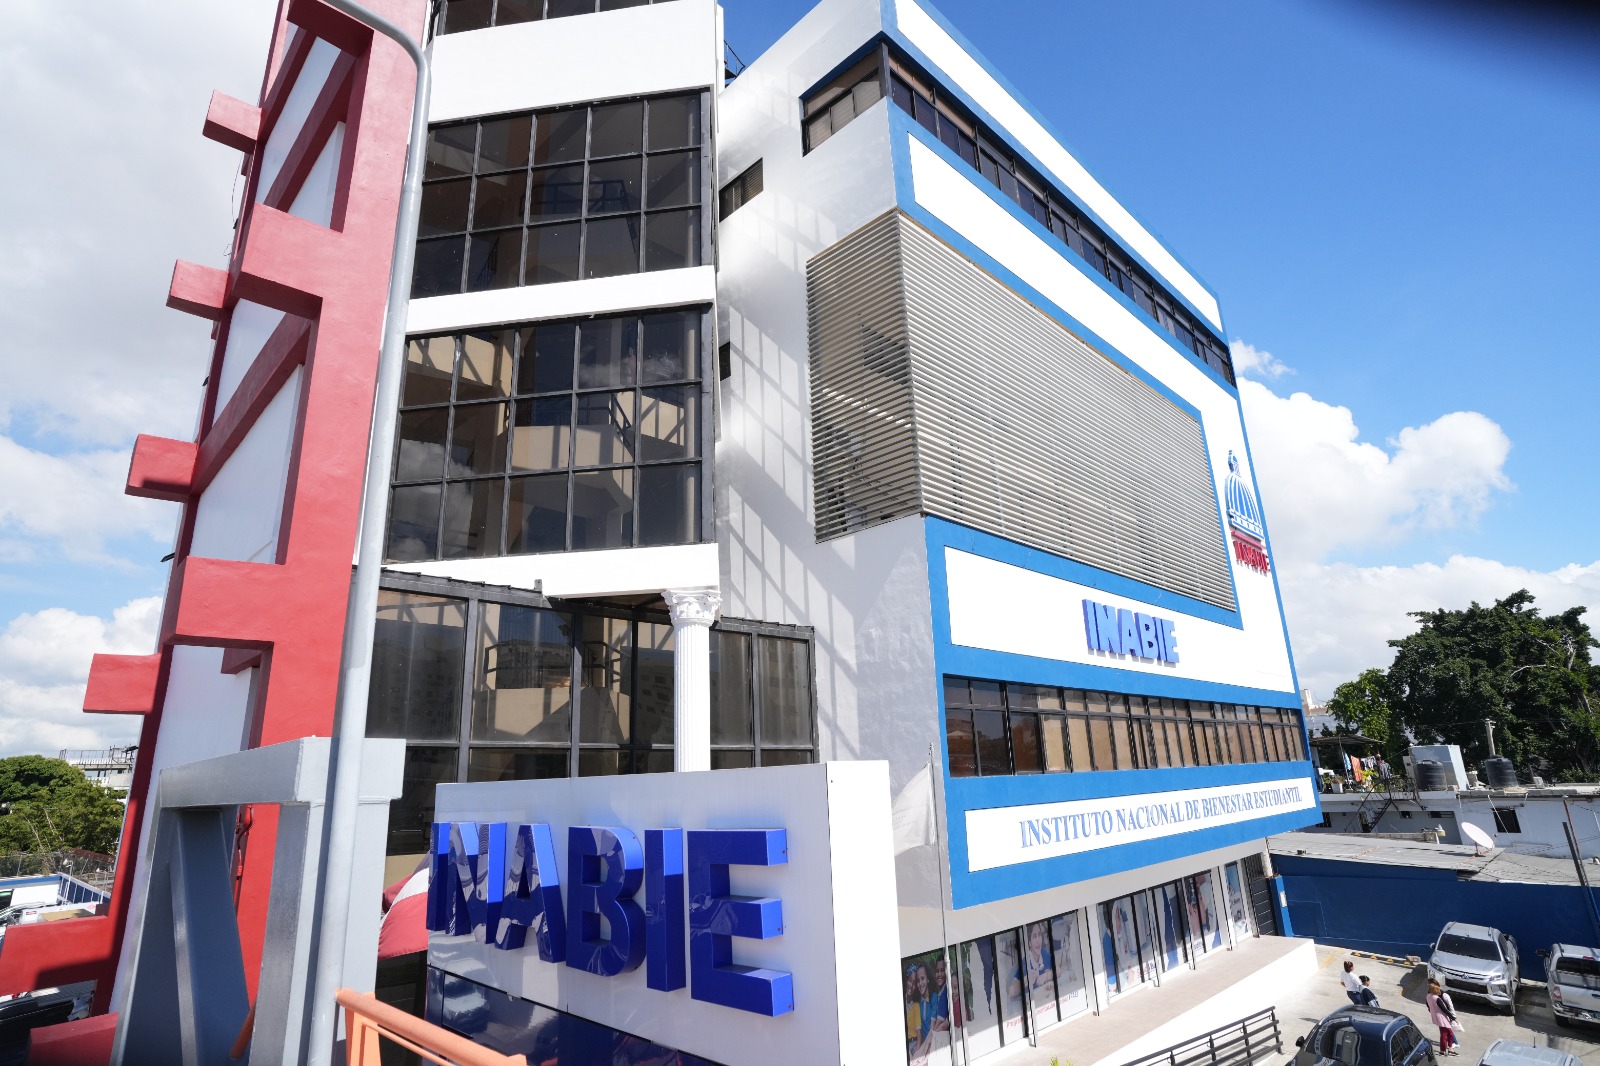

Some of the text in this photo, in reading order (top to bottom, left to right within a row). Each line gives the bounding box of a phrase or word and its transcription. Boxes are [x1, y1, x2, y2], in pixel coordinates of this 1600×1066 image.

[1082, 599, 1180, 663] INABIE
[1019, 786, 1302, 848] INSTITUTO NACIONAL DE BIENESTAR ESTUDIANTIL
[426, 822, 794, 1017] INABIE
